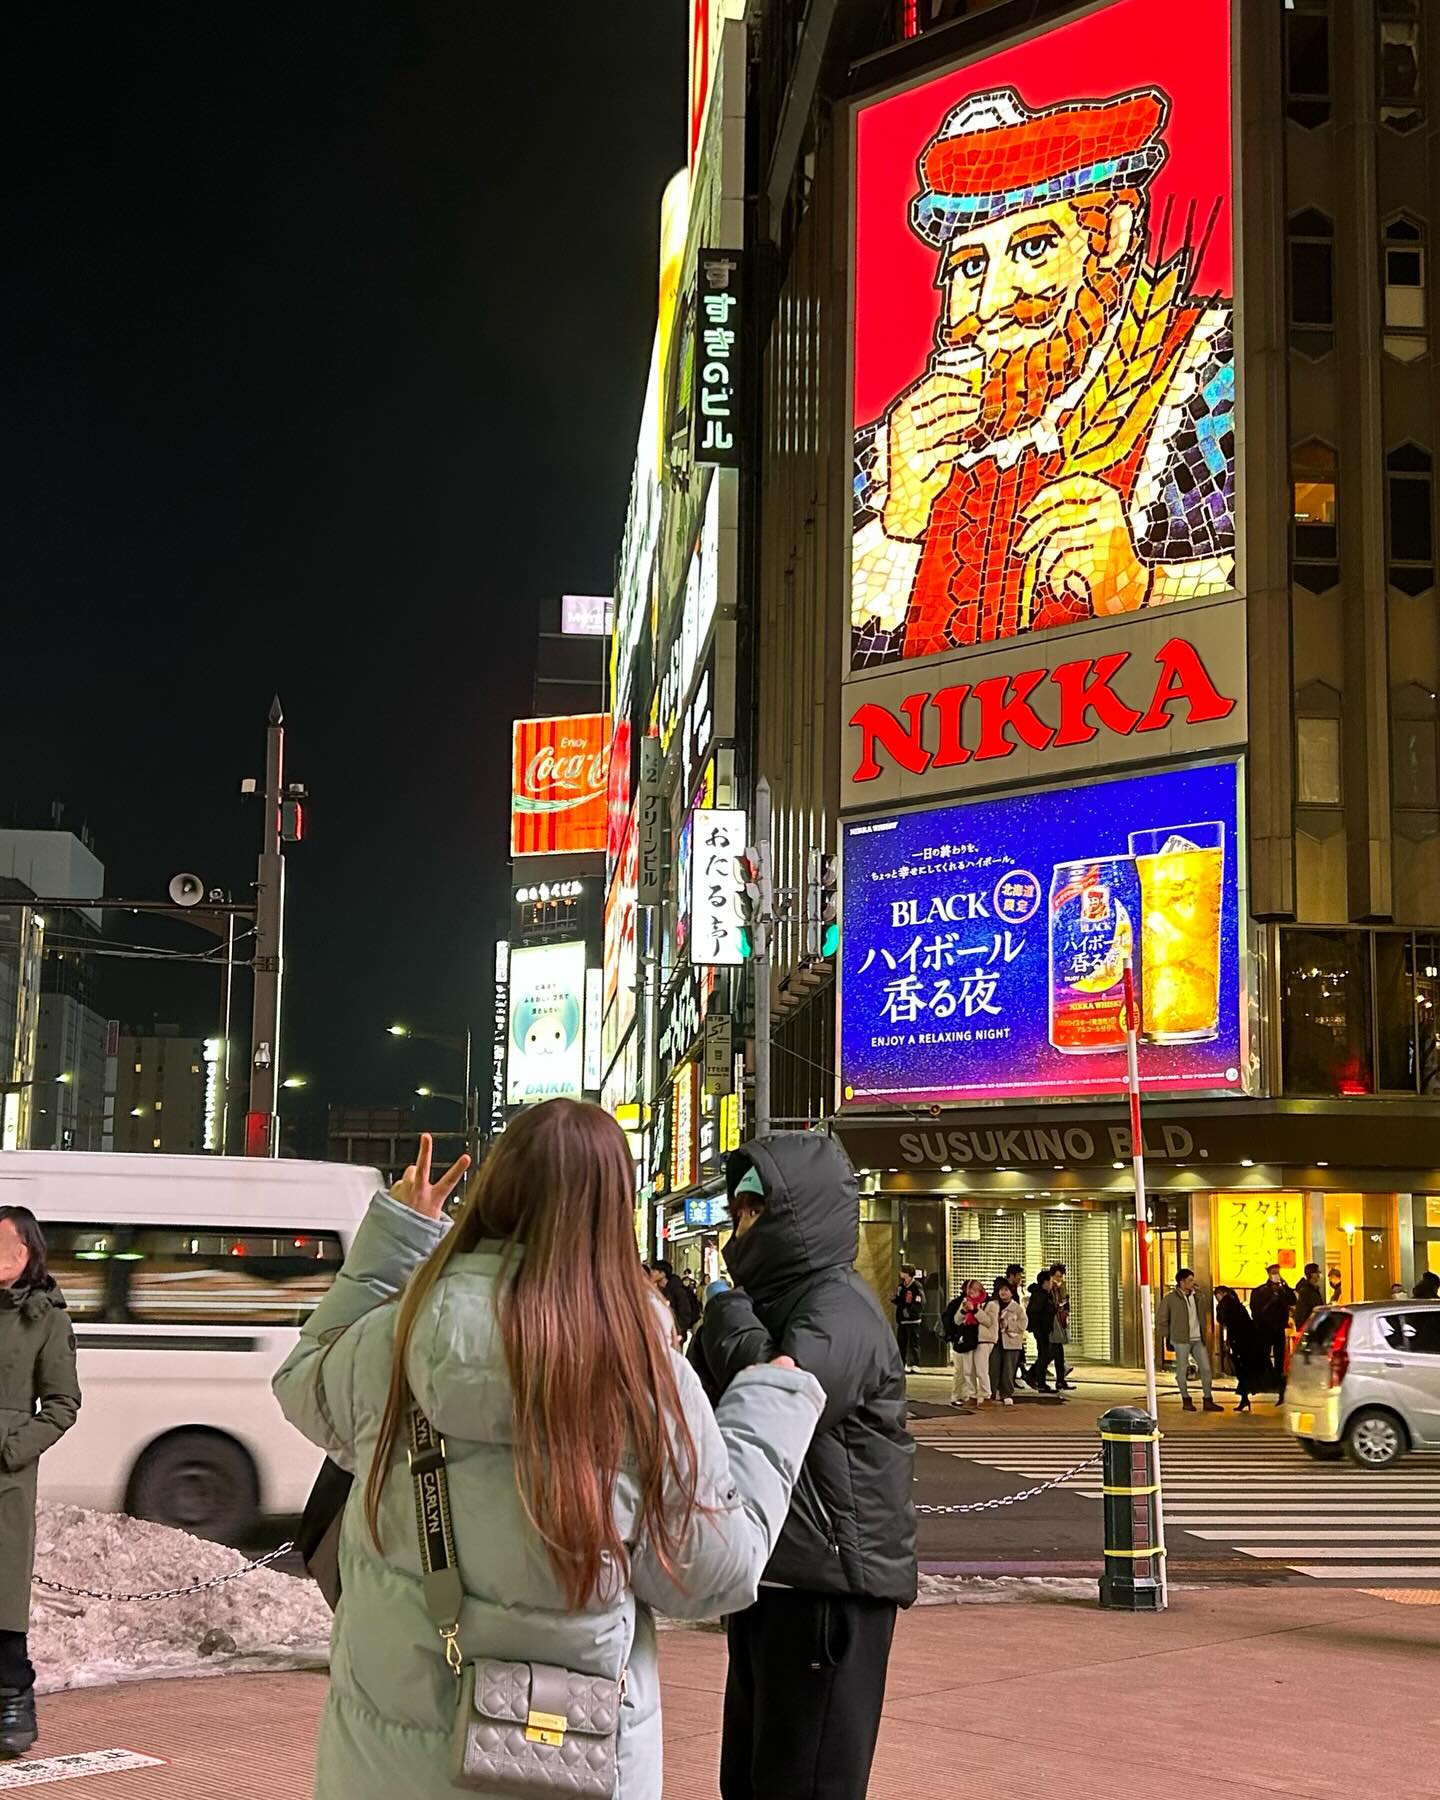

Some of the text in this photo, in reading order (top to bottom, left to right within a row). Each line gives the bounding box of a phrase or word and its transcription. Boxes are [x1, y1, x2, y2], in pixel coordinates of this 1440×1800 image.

[702, 258, 736, 449] すすきのビル
[848, 636, 1238, 783] NIKKA
[560, 737, 588, 750] Enjoy
[911, 843, 979, 860] 一日の終わりを、
[871, 855, 1016, 881] ちょっと幸せにしてくれるハイボール。
[1001, 883, 1036, 898] 北海道
[891, 891, 991, 928] BLACK
[1002, 898, 1029, 913] 限定
[857, 928, 1029, 975] ハイボール
[878, 970, 1004, 1024] 香る夜
[871, 1027, 1010, 1048] ENJOY A RELAXING NIGHT
[525, 1082, 575, 1095] DAIKIN
[714, 1082, 722, 1091] 3
[900, 1125, 1208, 1164] SUSUKINO BLD.
[423, 1472, 441, 1535] CARLYN
